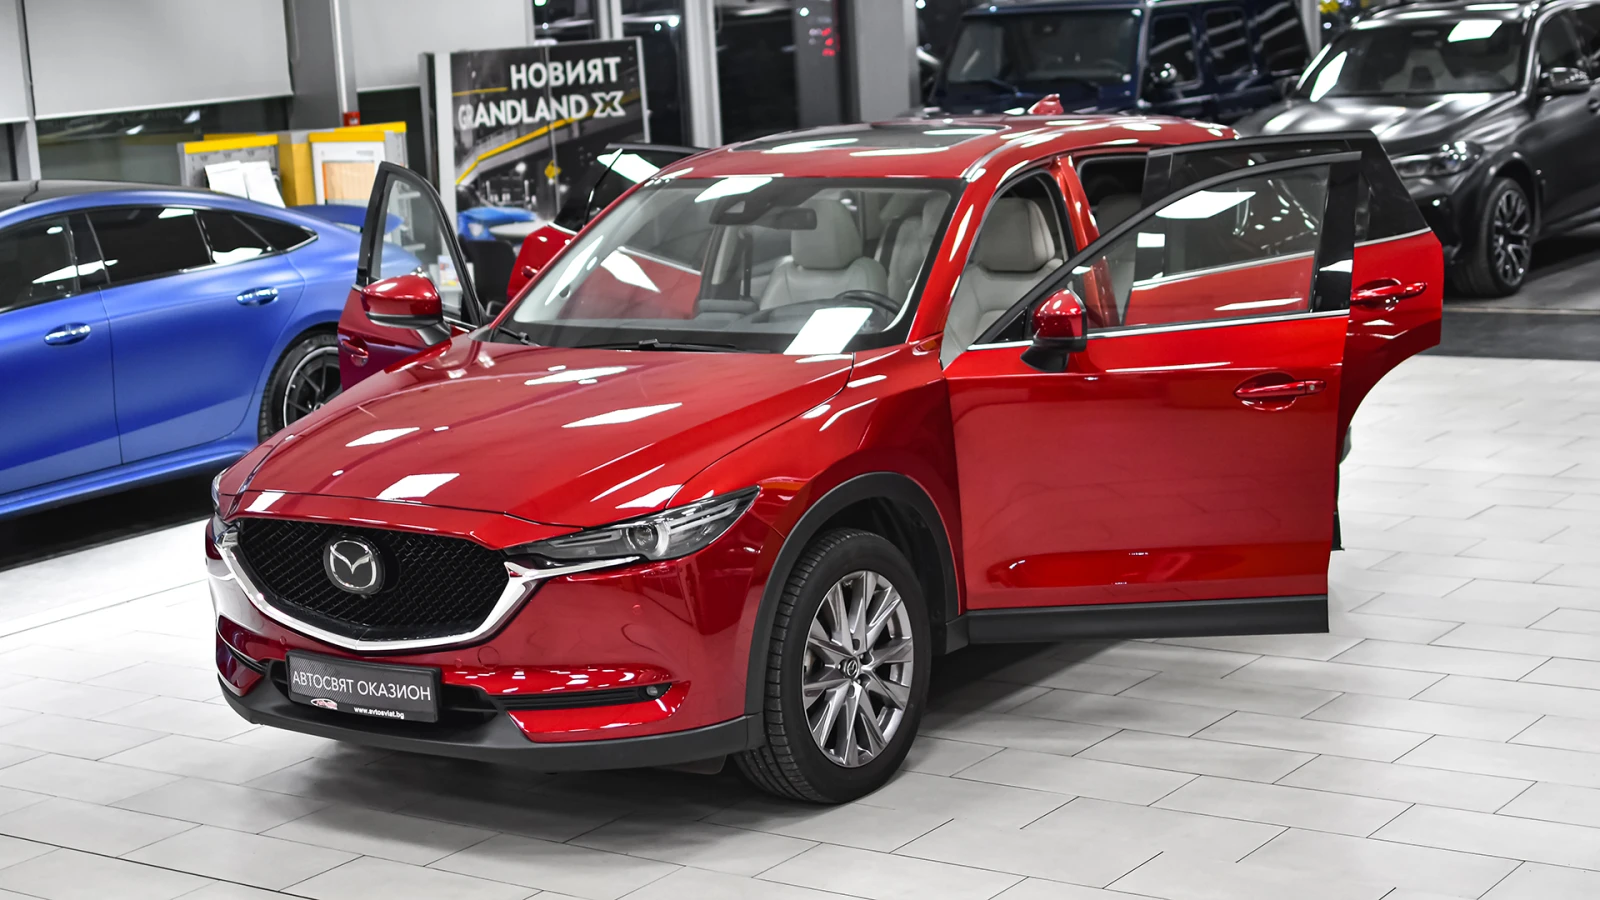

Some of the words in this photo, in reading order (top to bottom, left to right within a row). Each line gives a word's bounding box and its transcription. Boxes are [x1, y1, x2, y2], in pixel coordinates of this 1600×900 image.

[510, 56, 621, 90] НОВИЯТ
[292, 671, 354, 693] АВТОСВЯТ
[357, 680, 431, 701] ОКАЗИОН
[354, 706, 405, 719] www.avtosviat.bg
